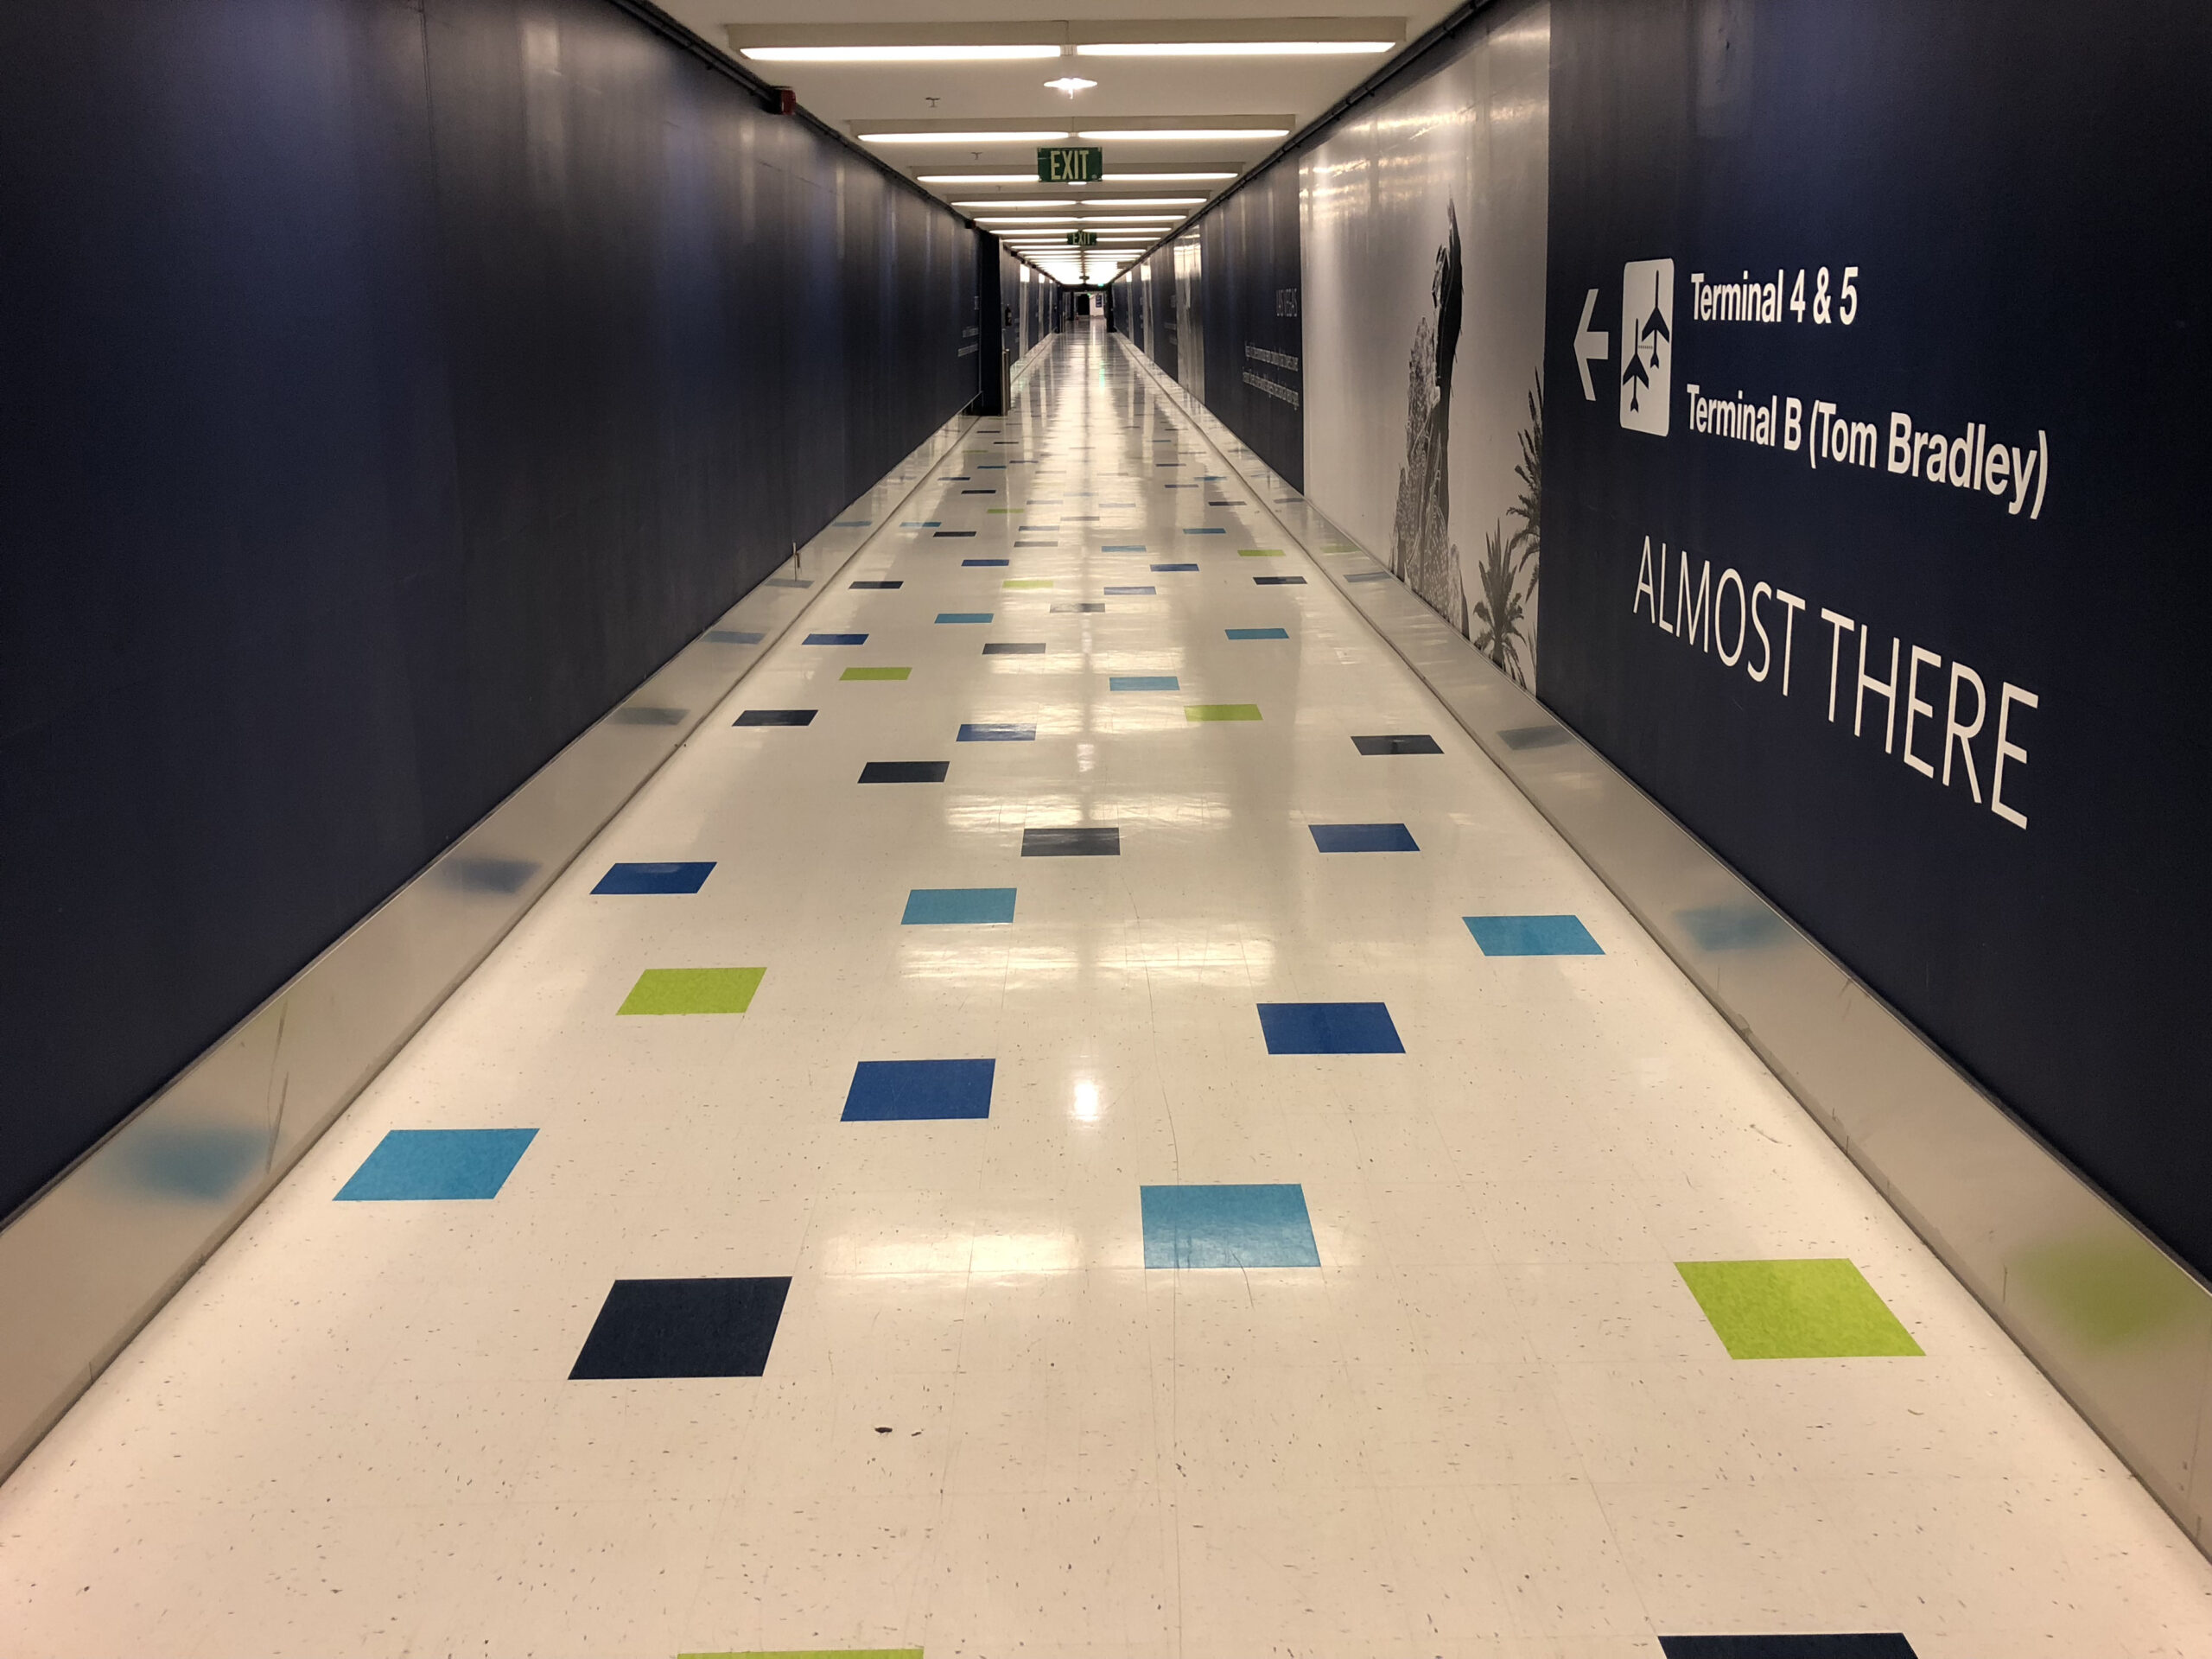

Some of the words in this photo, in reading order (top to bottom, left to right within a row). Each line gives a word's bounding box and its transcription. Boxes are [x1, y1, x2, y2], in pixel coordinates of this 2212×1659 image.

[1050, 149, 1089, 180] EXIT
[1072, 232, 1090, 245] EXIT
[1690, 269, 1783, 322] Terminal
[1789, 269, 1806, 323] 4
[1813, 266, 1832, 325] &
[1839, 266, 1859, 326] 5
[1687, 385, 1777, 447] Terminal
[1783, 397, 1802, 451] B
[1810, 399, 1878, 469] (Tom
[1887, 411, 2048, 520] Bradley)
[1633, 535, 1806, 696] ALMOST
[1821, 607, 2039, 830] THERE
